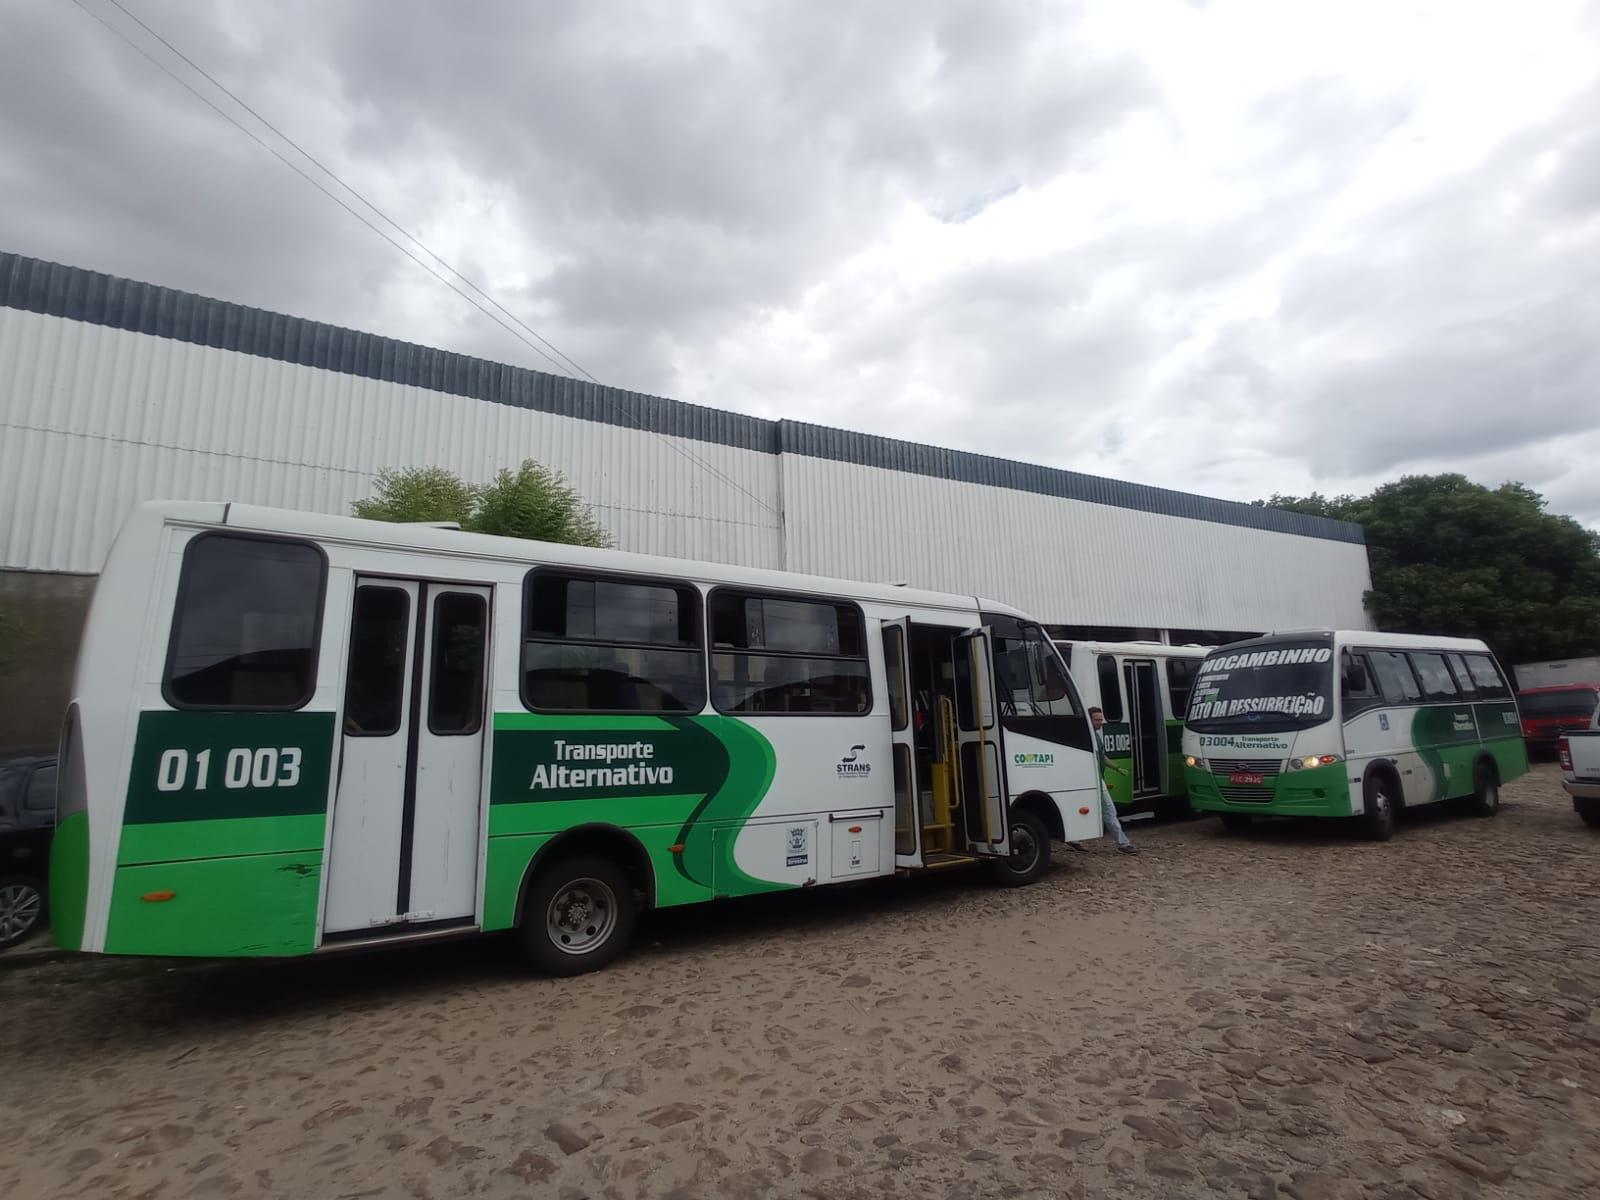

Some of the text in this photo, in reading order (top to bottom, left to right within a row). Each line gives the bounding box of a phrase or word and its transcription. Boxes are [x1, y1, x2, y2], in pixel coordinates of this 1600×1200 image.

[1211, 700, 1228, 719] DA
[1104, 734, 1115, 752] 03
[1200, 736, 1235, 747] 03004
[1234, 740, 1288, 749] Alternativo
[554, 740, 654, 764] Transporte
[157, 747, 302, 792] 01 003
[529, 761, 674, 790] Alternativo
[836, 763, 871, 773] STRANS
